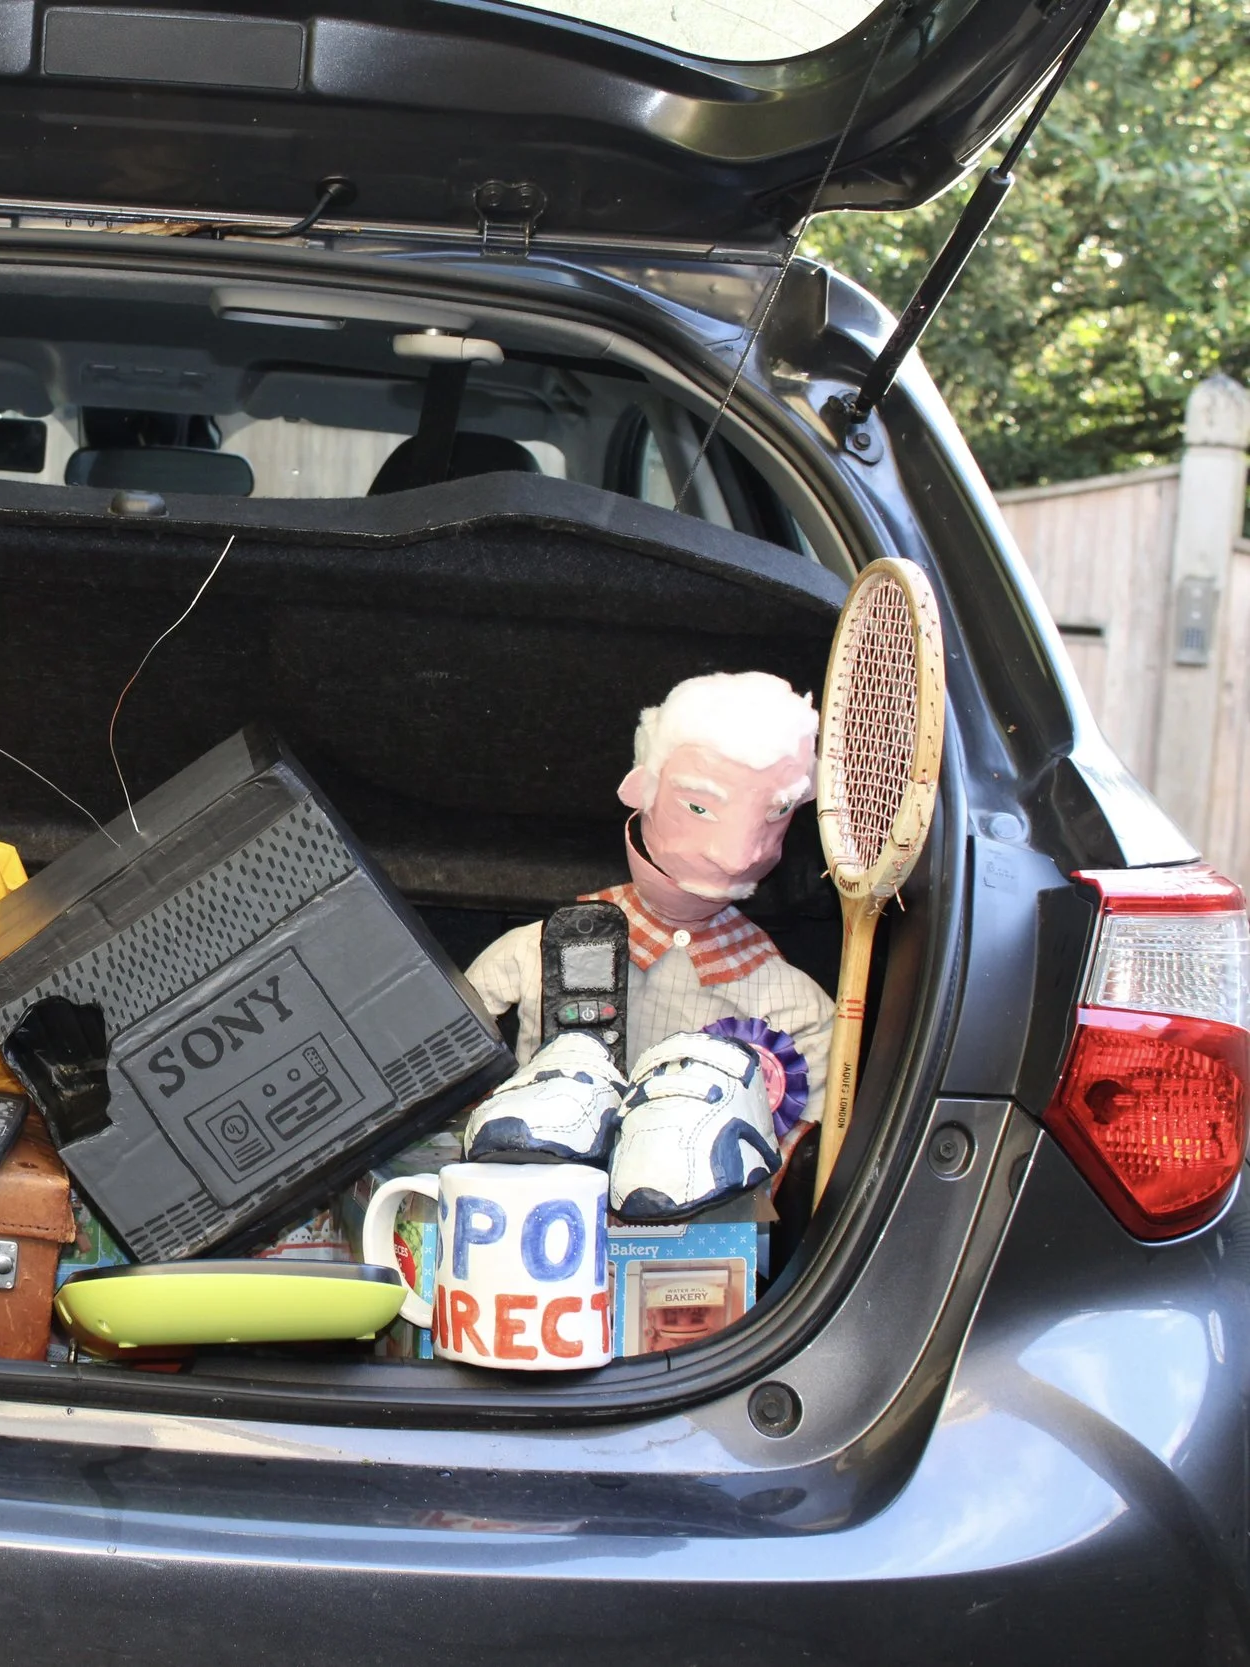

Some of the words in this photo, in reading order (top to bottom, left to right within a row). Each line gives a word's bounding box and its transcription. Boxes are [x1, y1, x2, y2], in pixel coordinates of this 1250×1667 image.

[838, 875, 860, 893] COUNTY
[148, 975, 294, 1098] SONY
[841, 1062, 852, 1093] JAQUES
[838, 1097, 848, 1129] LONDON
[438, 1187, 608, 1288] PO
[393, 1244, 409, 1258] ECES
[610, 1243, 660, 1258] Bakery
[665, 1292, 708, 1302] BAKERY
